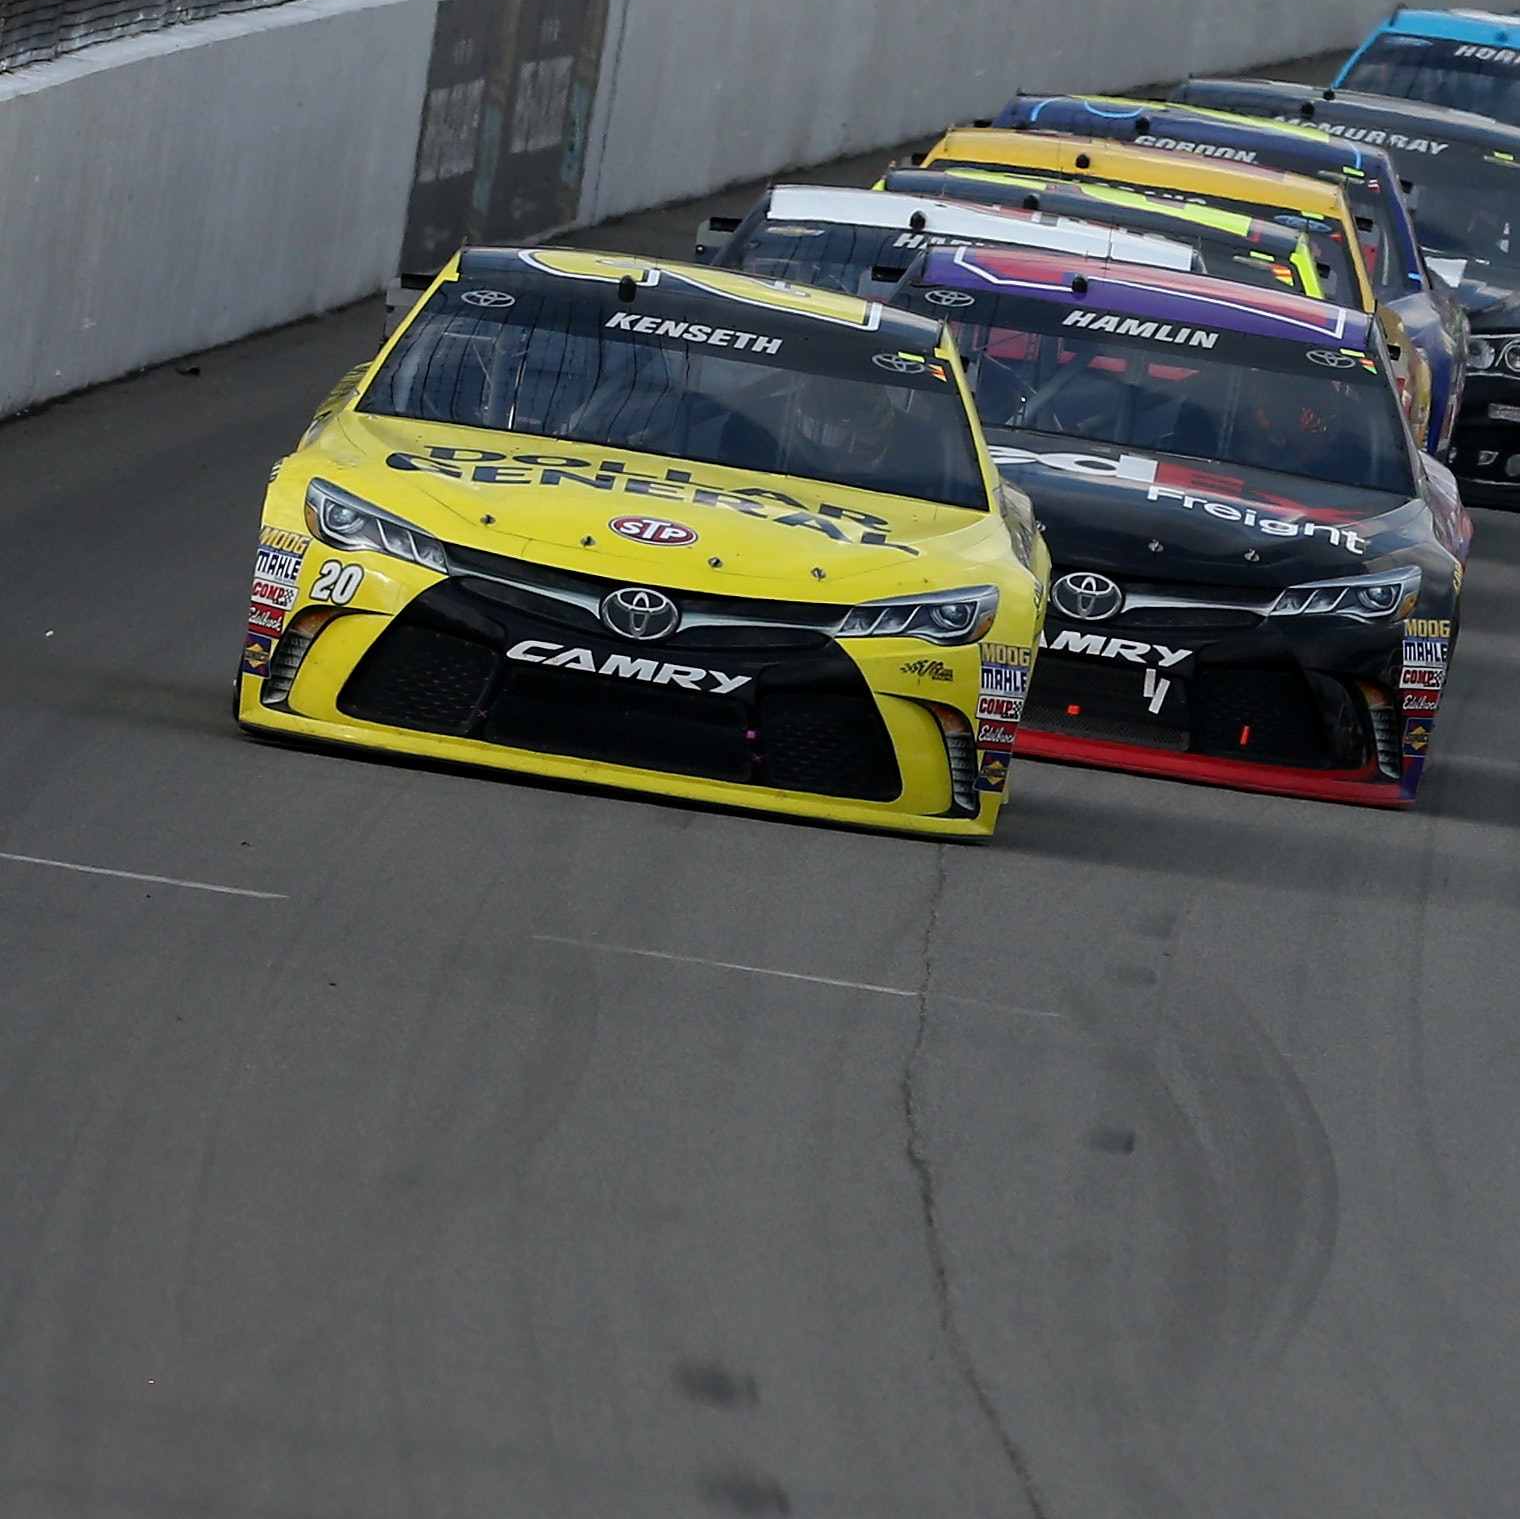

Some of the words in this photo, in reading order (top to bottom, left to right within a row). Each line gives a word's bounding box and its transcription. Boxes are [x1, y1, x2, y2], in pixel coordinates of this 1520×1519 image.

[1134, 134, 1258, 164] GORDON
[604, 312, 782, 356] KENSETH
[1062, 310, 1219, 349] HAMLIN
[424, 444, 892, 533] DOLLAR
[987, 444, 1374, 527] edEx
[384, 451, 920, 557] GENERAL
[621, 518, 689, 543] STP
[1146, 484, 1369, 556] Freight
[260, 528, 310, 553] MOOG
[255, 552, 302, 580] MAHLE
[252, 581, 285, 601] COMP
[309, 559, 365, 606] 20
[1405, 619, 1450, 638] MOOG
[982, 644, 1031, 667] MOOG
[1037, 630, 1194, 667] MRY
[1404, 641, 1449, 663] MAHLE
[505, 640, 752, 694] CAMRY
[981, 667, 1028, 693] MAHLE
[1402, 669, 1434, 686] COMP
[979, 697, 1013, 715] COMP
